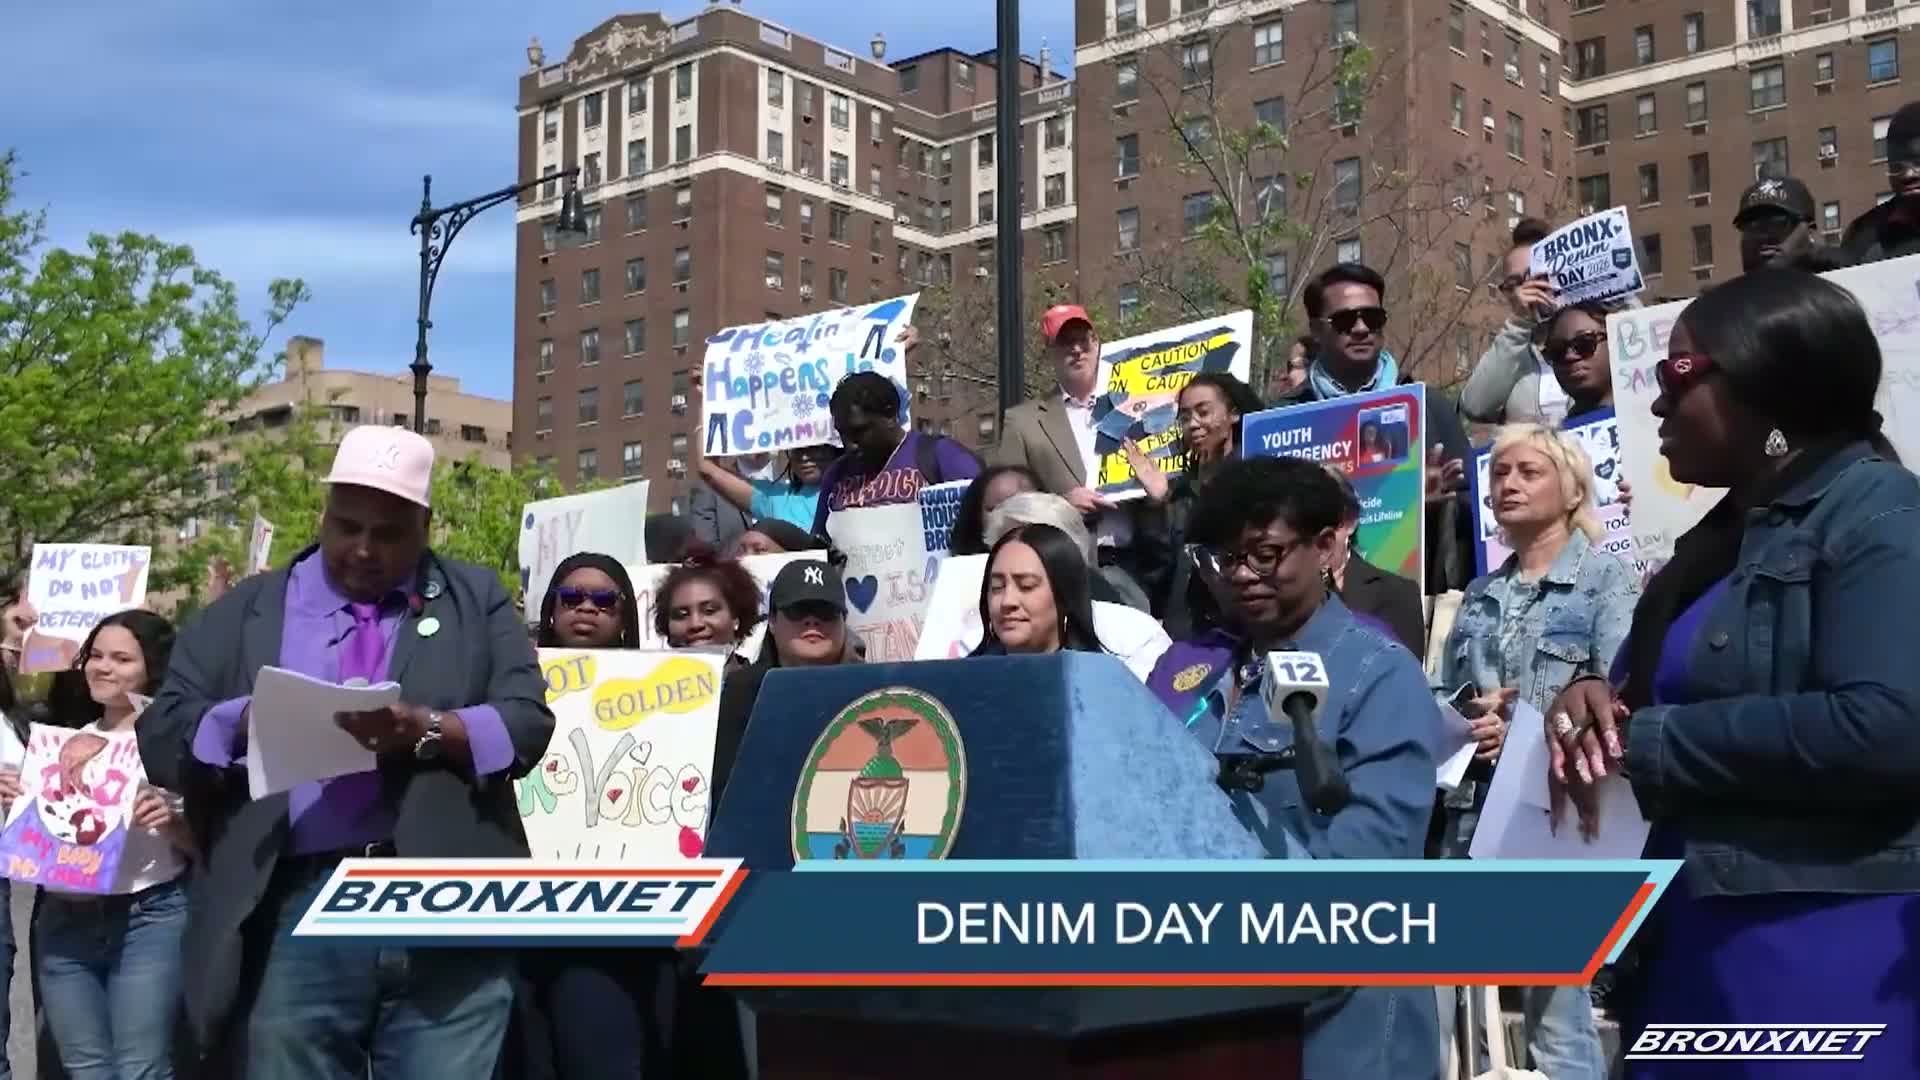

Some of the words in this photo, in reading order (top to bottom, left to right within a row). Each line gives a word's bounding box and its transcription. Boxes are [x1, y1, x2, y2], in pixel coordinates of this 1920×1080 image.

[1544, 218, 1613, 261] BRONX
[1549, 241, 1609, 275] Denim
[1558, 267, 1586, 287] DAY
[1141, 340, 1210, 370] CAUTION
[706, 356, 831, 408] Happens
[1262, 427, 1312, 450] YOUTH
[922, 504, 960, 529] HOUS
[924, 529, 952, 551] BRO
[37, 548, 76, 572] MY
[48, 579, 73, 598] DO
[1280, 663, 1323, 682] 12
[545, 655, 592, 693] OT
[594, 671, 714, 723] GOLDEN
